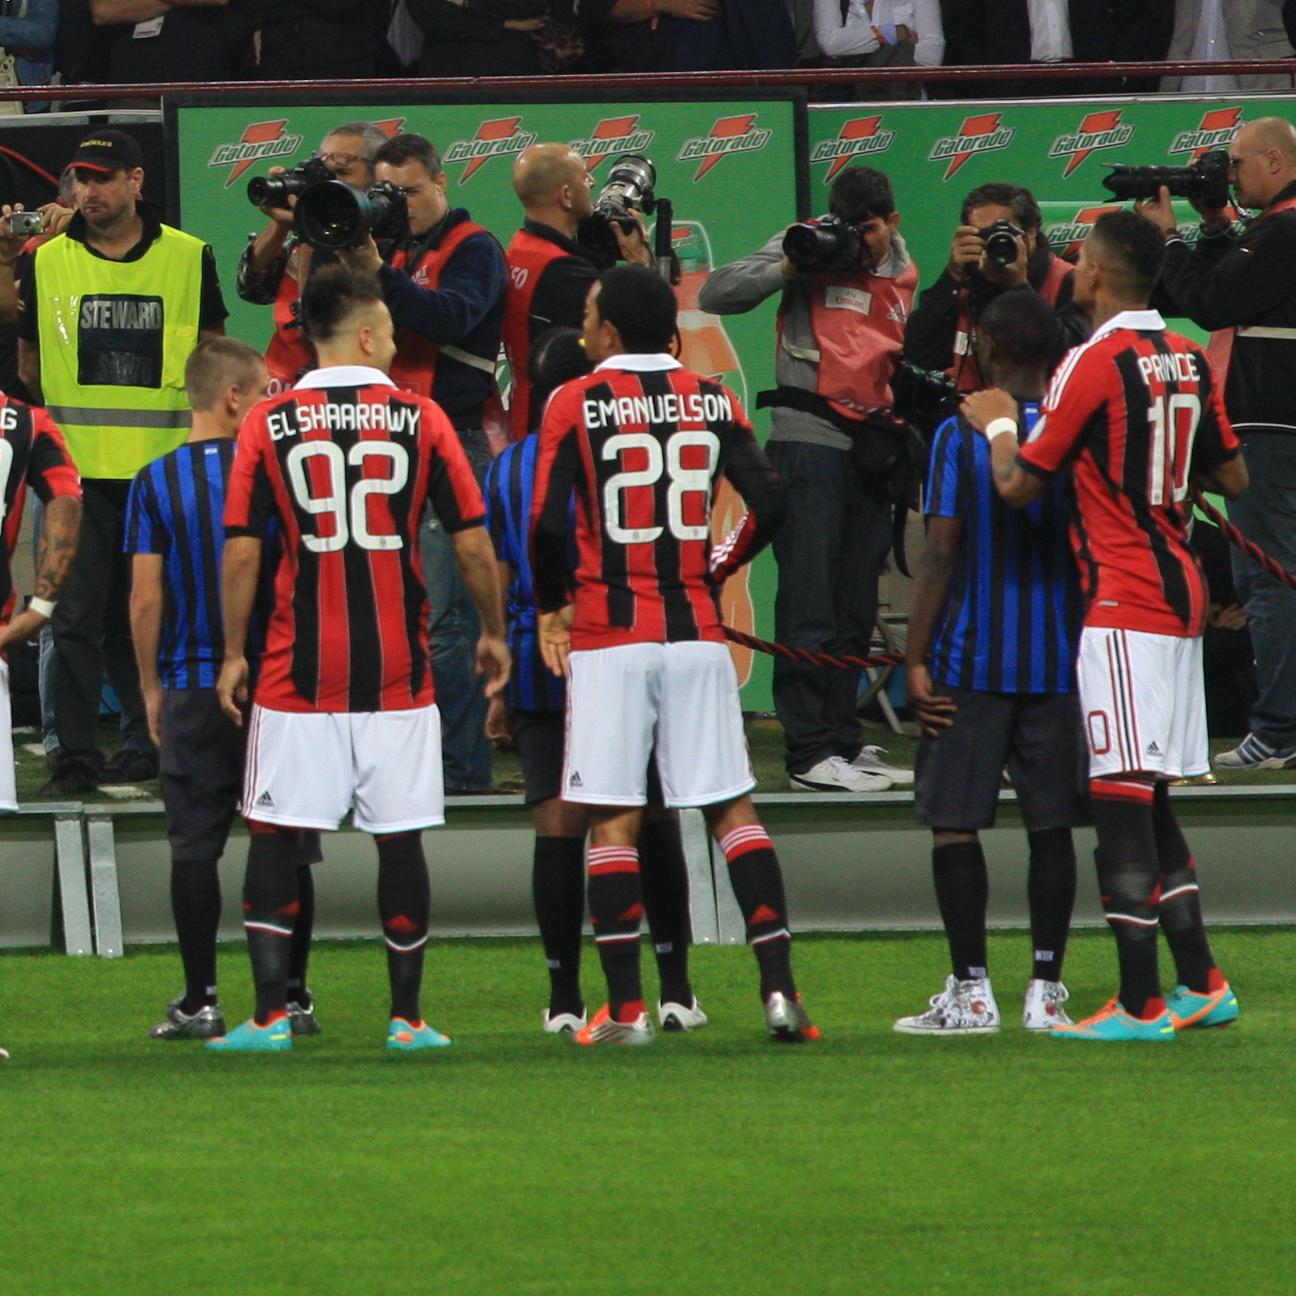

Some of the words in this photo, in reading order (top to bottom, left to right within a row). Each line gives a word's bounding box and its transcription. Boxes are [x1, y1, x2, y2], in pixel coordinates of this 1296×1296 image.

[215, 135, 298, 165] Gatorade
[447, 132, 532, 161] Gatorade
[682, 129, 766, 158] Gatorade
[814, 131, 893, 161] Gatorade
[933, 129, 1011, 158] Gatorade
[1052, 126, 1134, 156] Gatorade
[1173, 131, 1237, 151] Gatora
[1048, 224, 1092, 242] Gato
[81, 300, 161, 329] STEWARD
[1137, 352, 1201, 386] PRINCE
[267, 410, 296, 442] EL
[297, 403, 420, 437] SHAARAWY
[582, 396, 733, 430] EMANUELSON
[1146, 393, 1204, 507] 10
[285, 439, 409, 553] 92
[602, 430, 721, 545] 28
